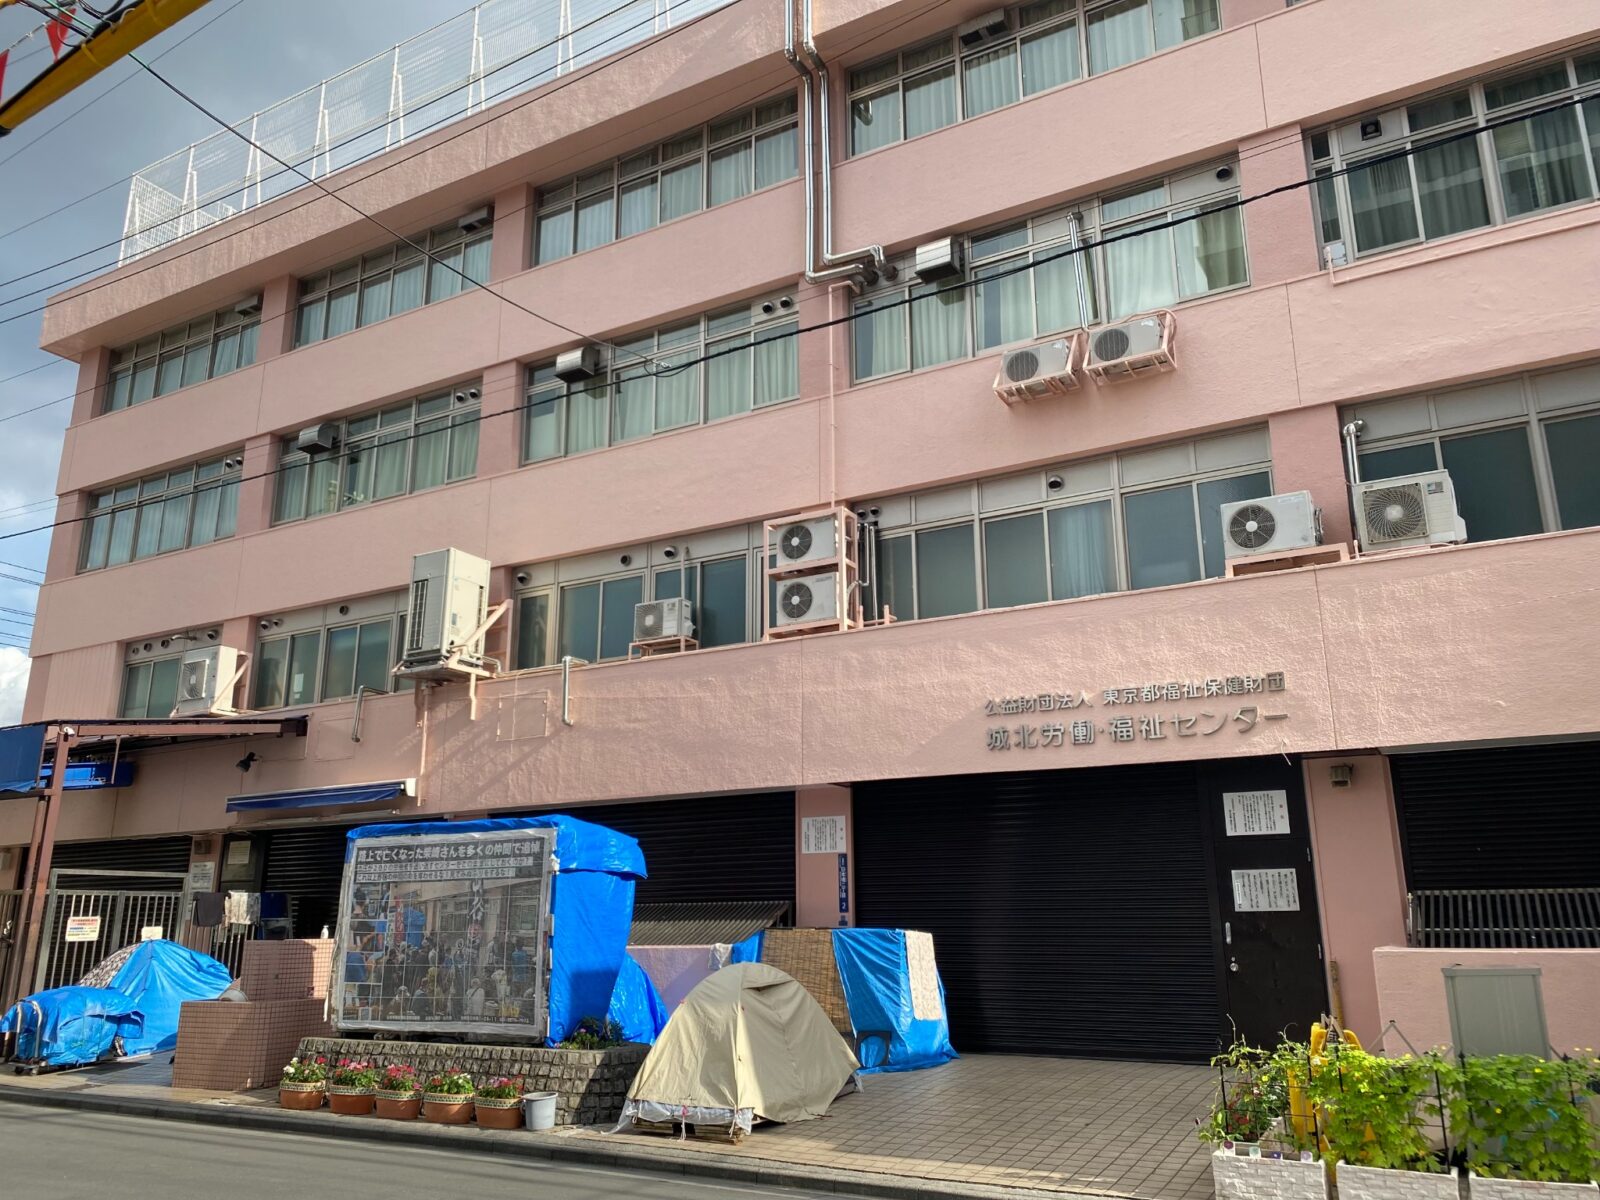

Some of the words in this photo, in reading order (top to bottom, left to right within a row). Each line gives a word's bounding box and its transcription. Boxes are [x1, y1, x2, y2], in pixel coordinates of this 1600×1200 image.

[984, 690, 1093, 717] 公益財団法人
[1103, 671, 1286, 705] 東京都福祉保健財団
[986, 705, 1289, 750] 城北労働・福祉センター
